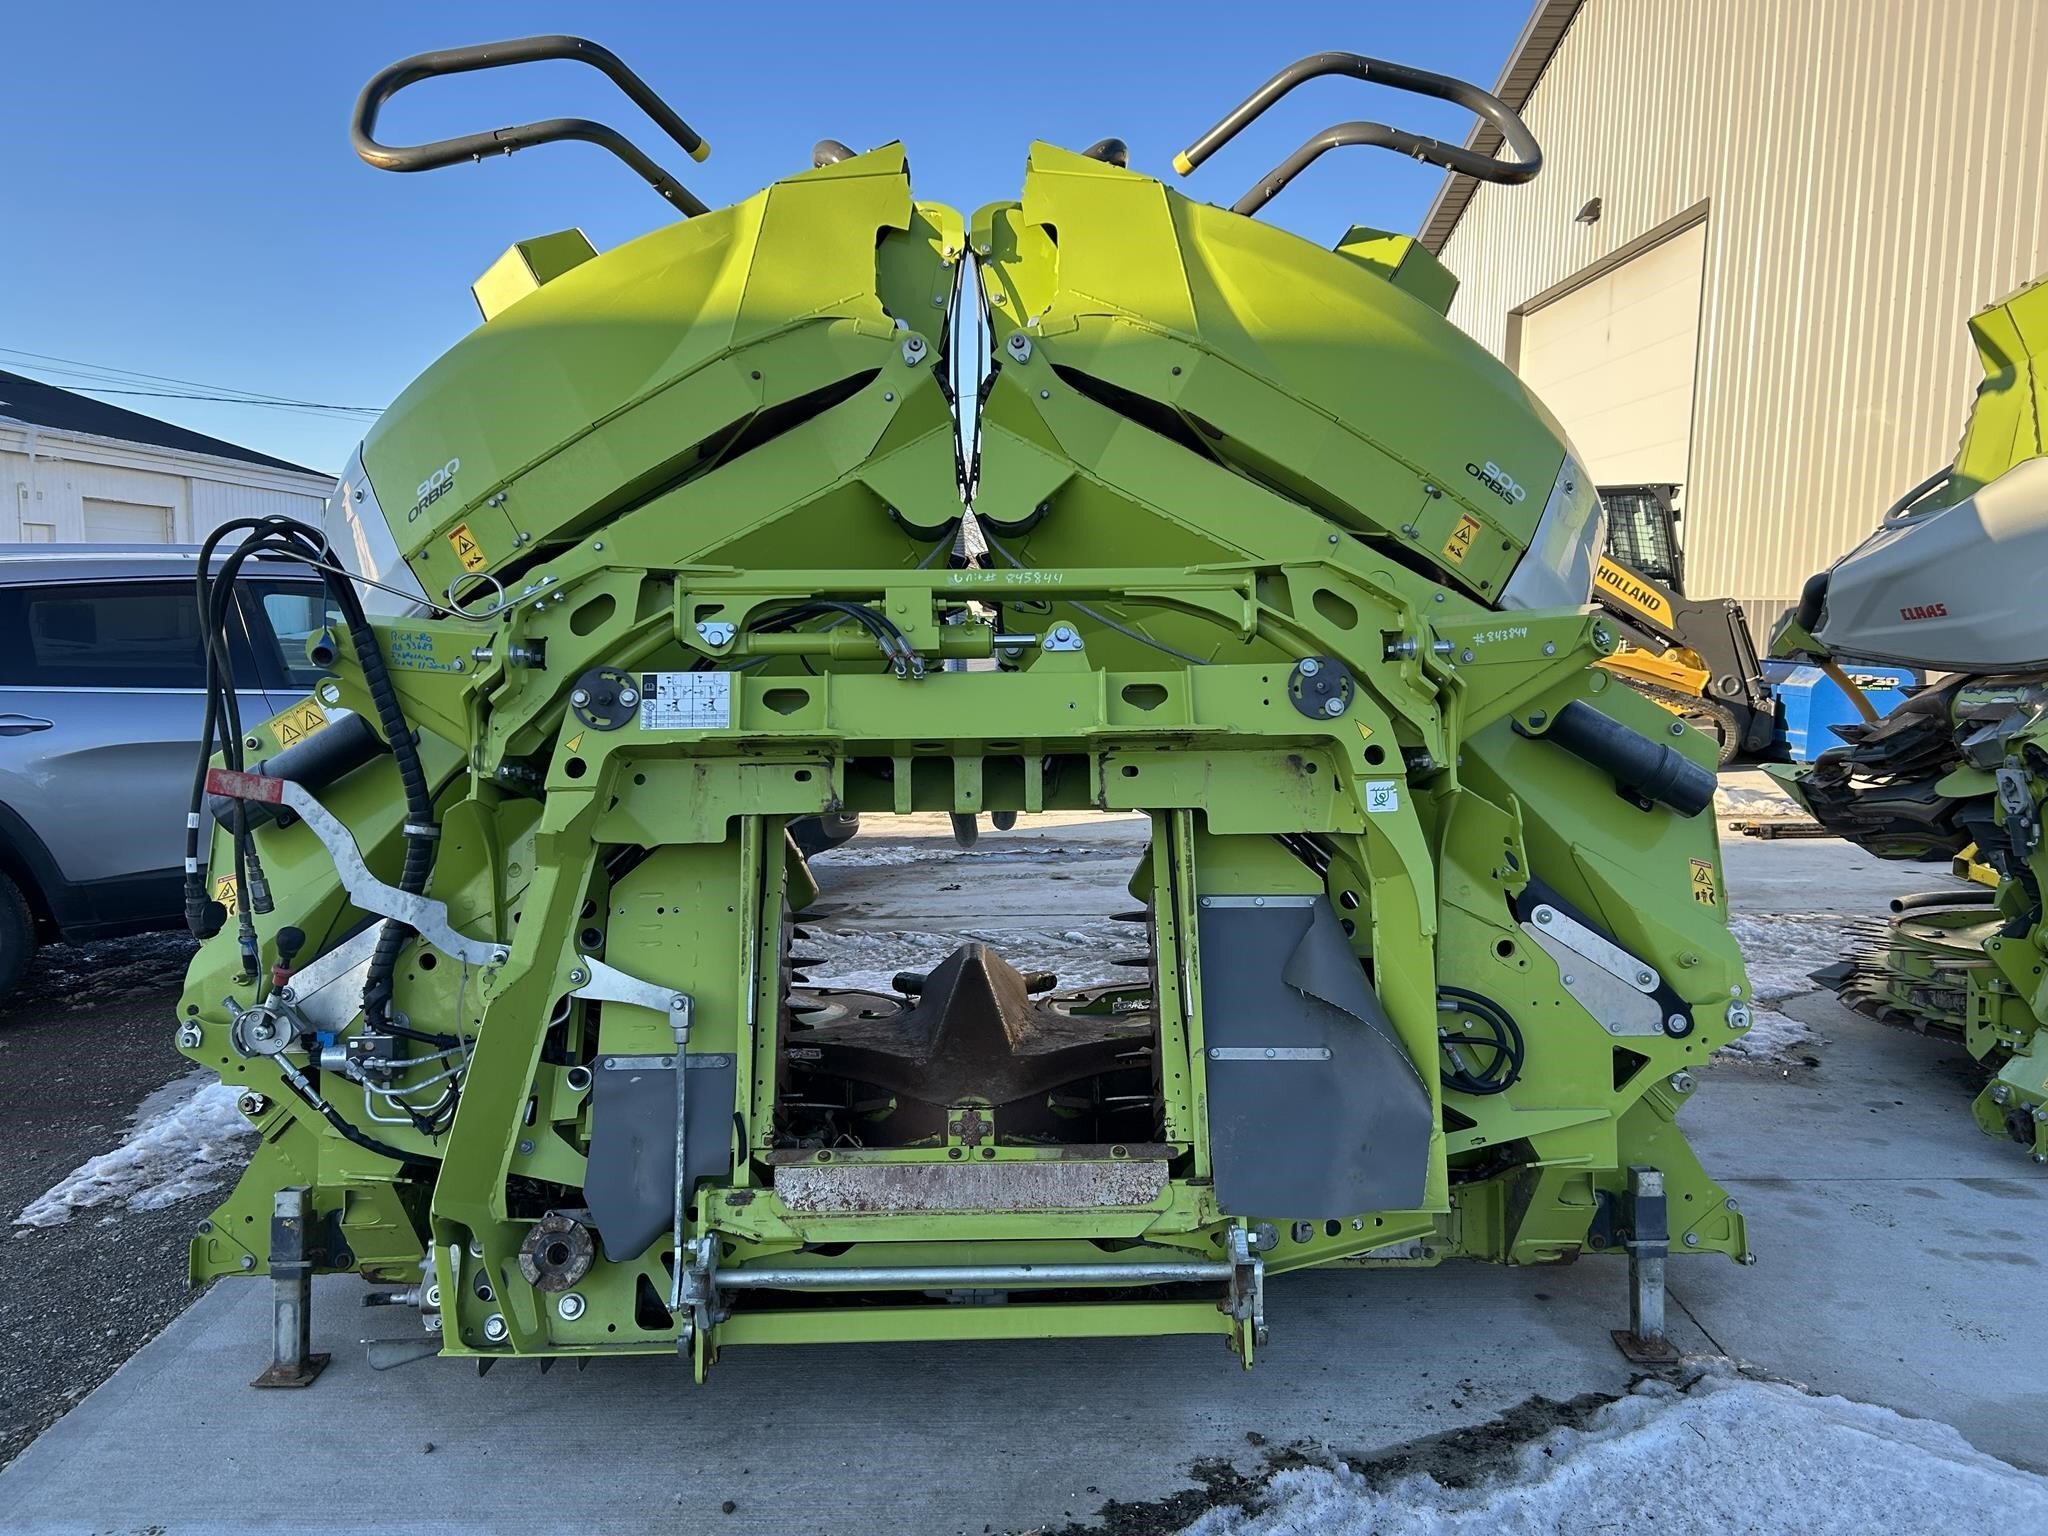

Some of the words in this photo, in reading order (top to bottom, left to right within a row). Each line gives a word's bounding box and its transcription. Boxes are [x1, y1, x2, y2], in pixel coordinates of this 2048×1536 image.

[416, 457, 460, 499] 900
[1482, 461, 1527, 503] 900
[408, 478, 454, 524] ORBIS
[1597, 565, 1661, 611] HOLLAND
[1900, 603, 1947, 621] CLAAS
